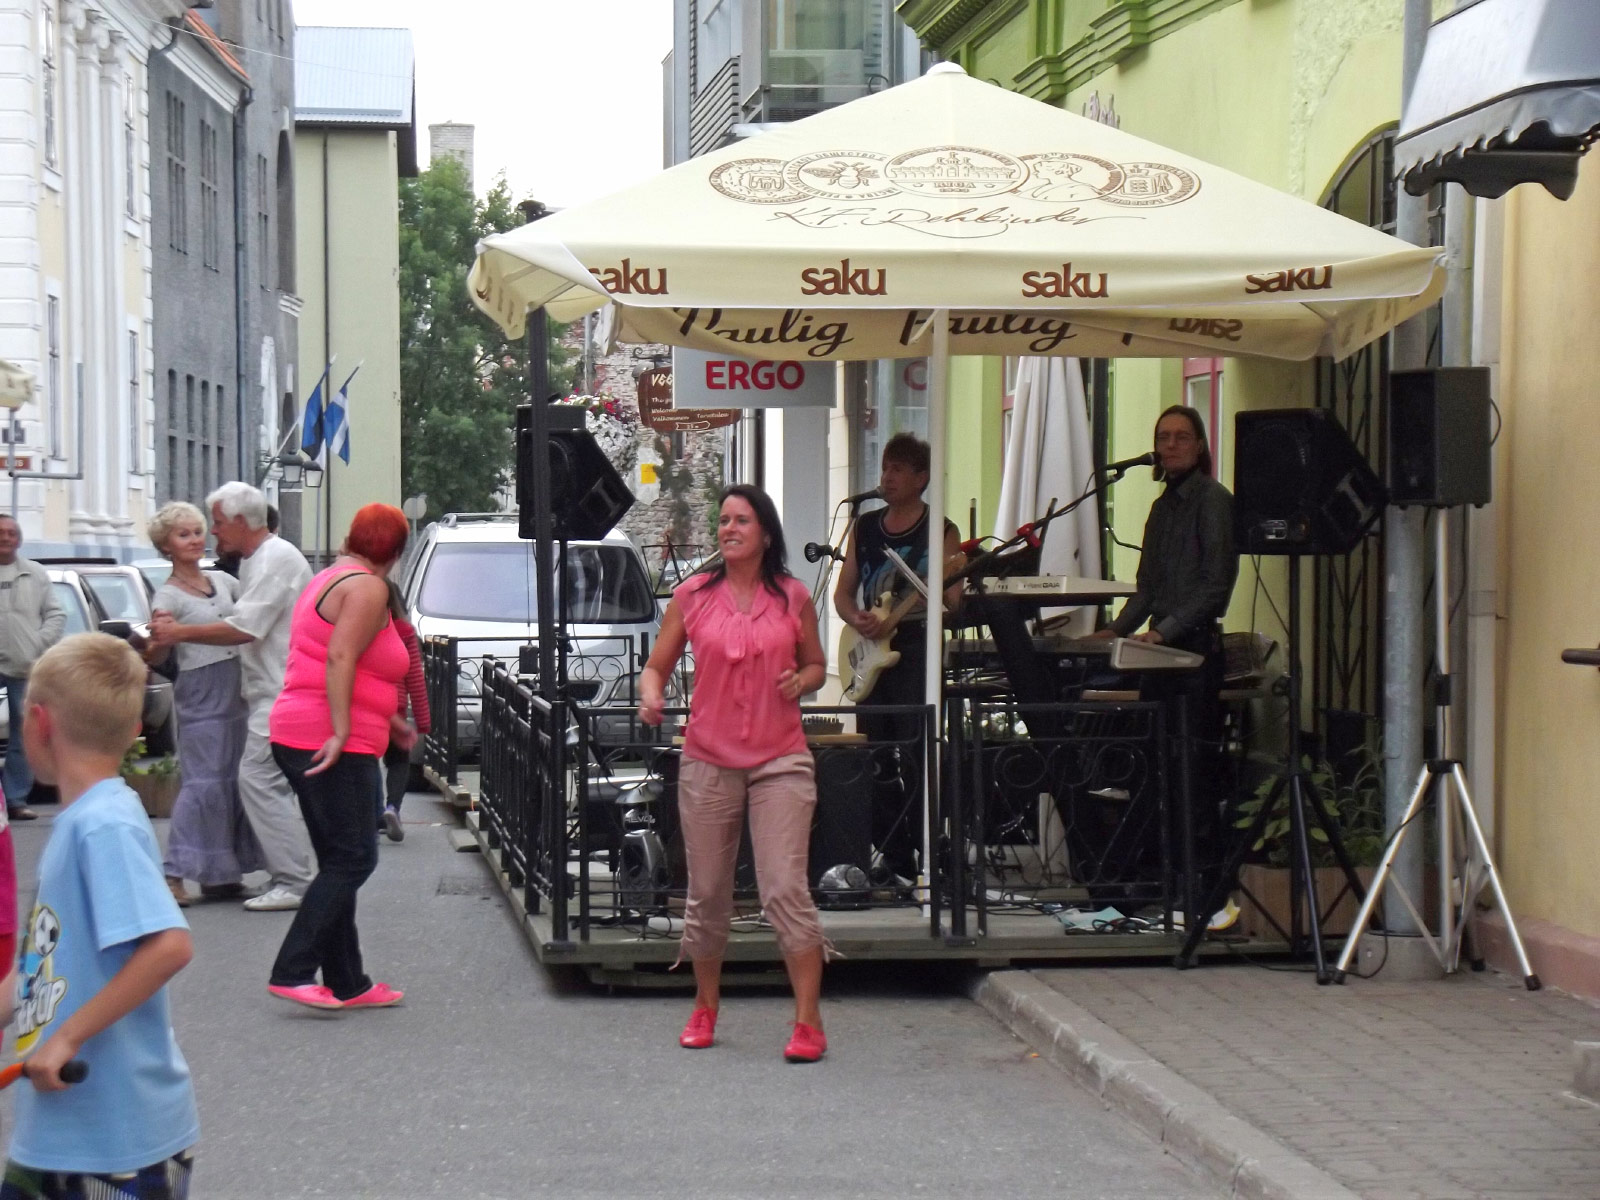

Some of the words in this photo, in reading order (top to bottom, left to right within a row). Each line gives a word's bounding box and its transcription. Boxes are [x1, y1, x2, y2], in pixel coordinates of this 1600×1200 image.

[588, 258, 669, 295] saku
[801, 258, 887, 296] saku
[1022, 262, 1109, 298] saku
[1245, 265, 1333, 294] saku
[705, 360, 805, 390] ERGO
